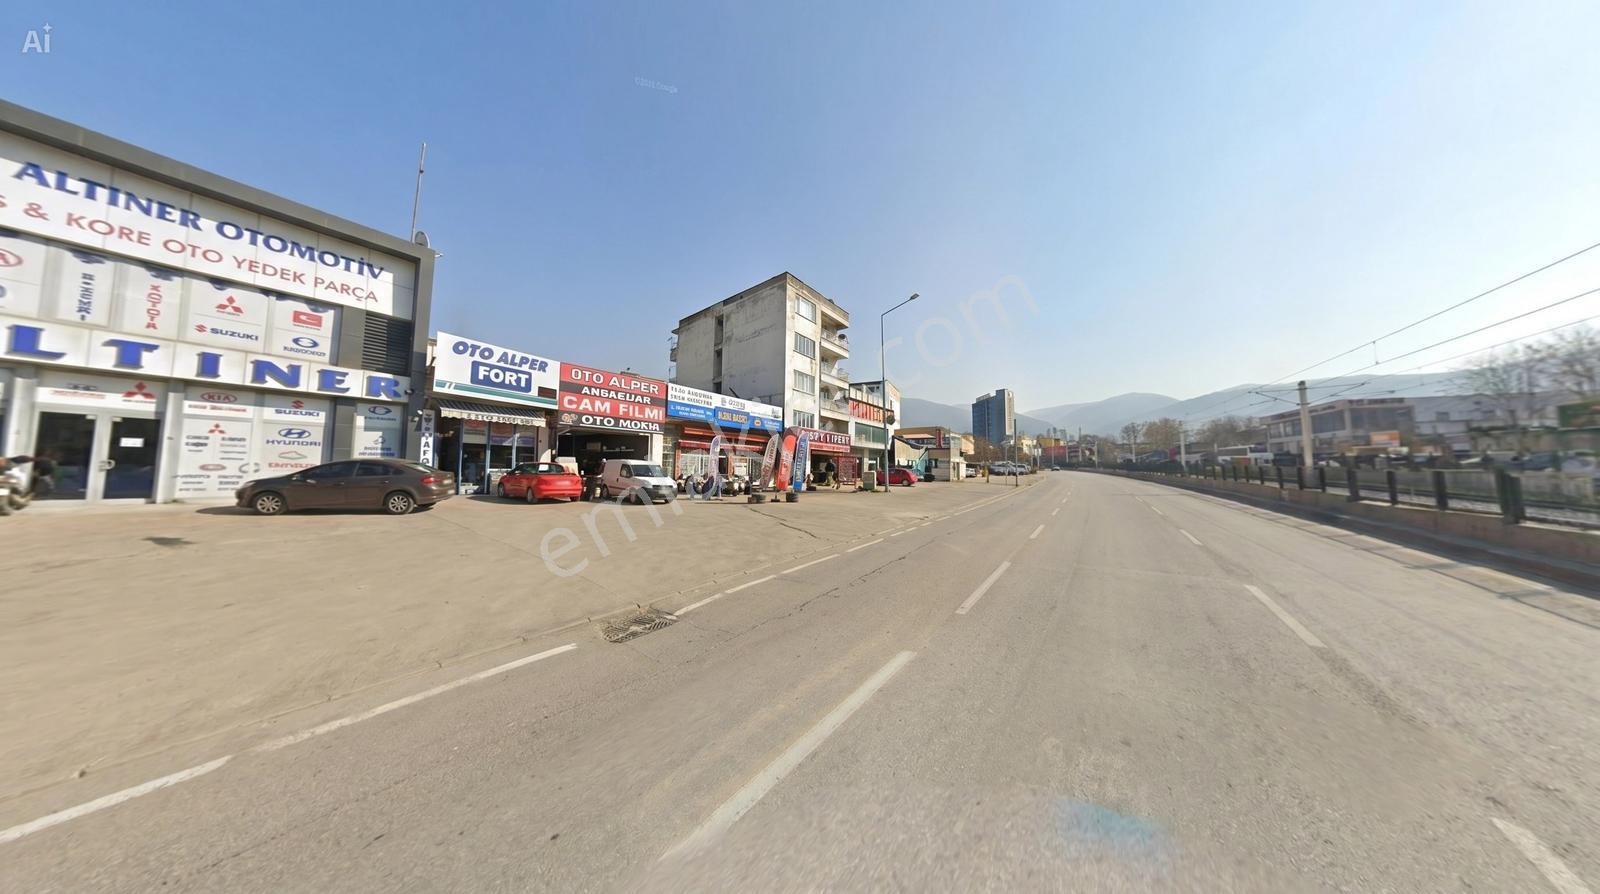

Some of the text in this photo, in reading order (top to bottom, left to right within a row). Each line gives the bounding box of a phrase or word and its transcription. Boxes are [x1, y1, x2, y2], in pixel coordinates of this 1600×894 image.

[12, 162, 385, 280] ALTINER OTOMOTİV
[23, 203, 49, 221] &
[66, 212, 151, 246] KORE
[163, 239, 223, 263] OTO
[233, 256, 306, 285] YEDEK
[314, 276, 379, 303] PARÇA
[210, 327, 259, 341] SUZUKI
[452, 340, 549, 373] OTO ALPER
[478, 366, 529, 387] FORT
[571, 368, 604, 384] OTO
[609, 376, 659, 394] ALPER
[274, 409, 320, 417] SUZUKI
[563, 395, 611, 413] CAM
[581, 415, 615, 426] OTO
